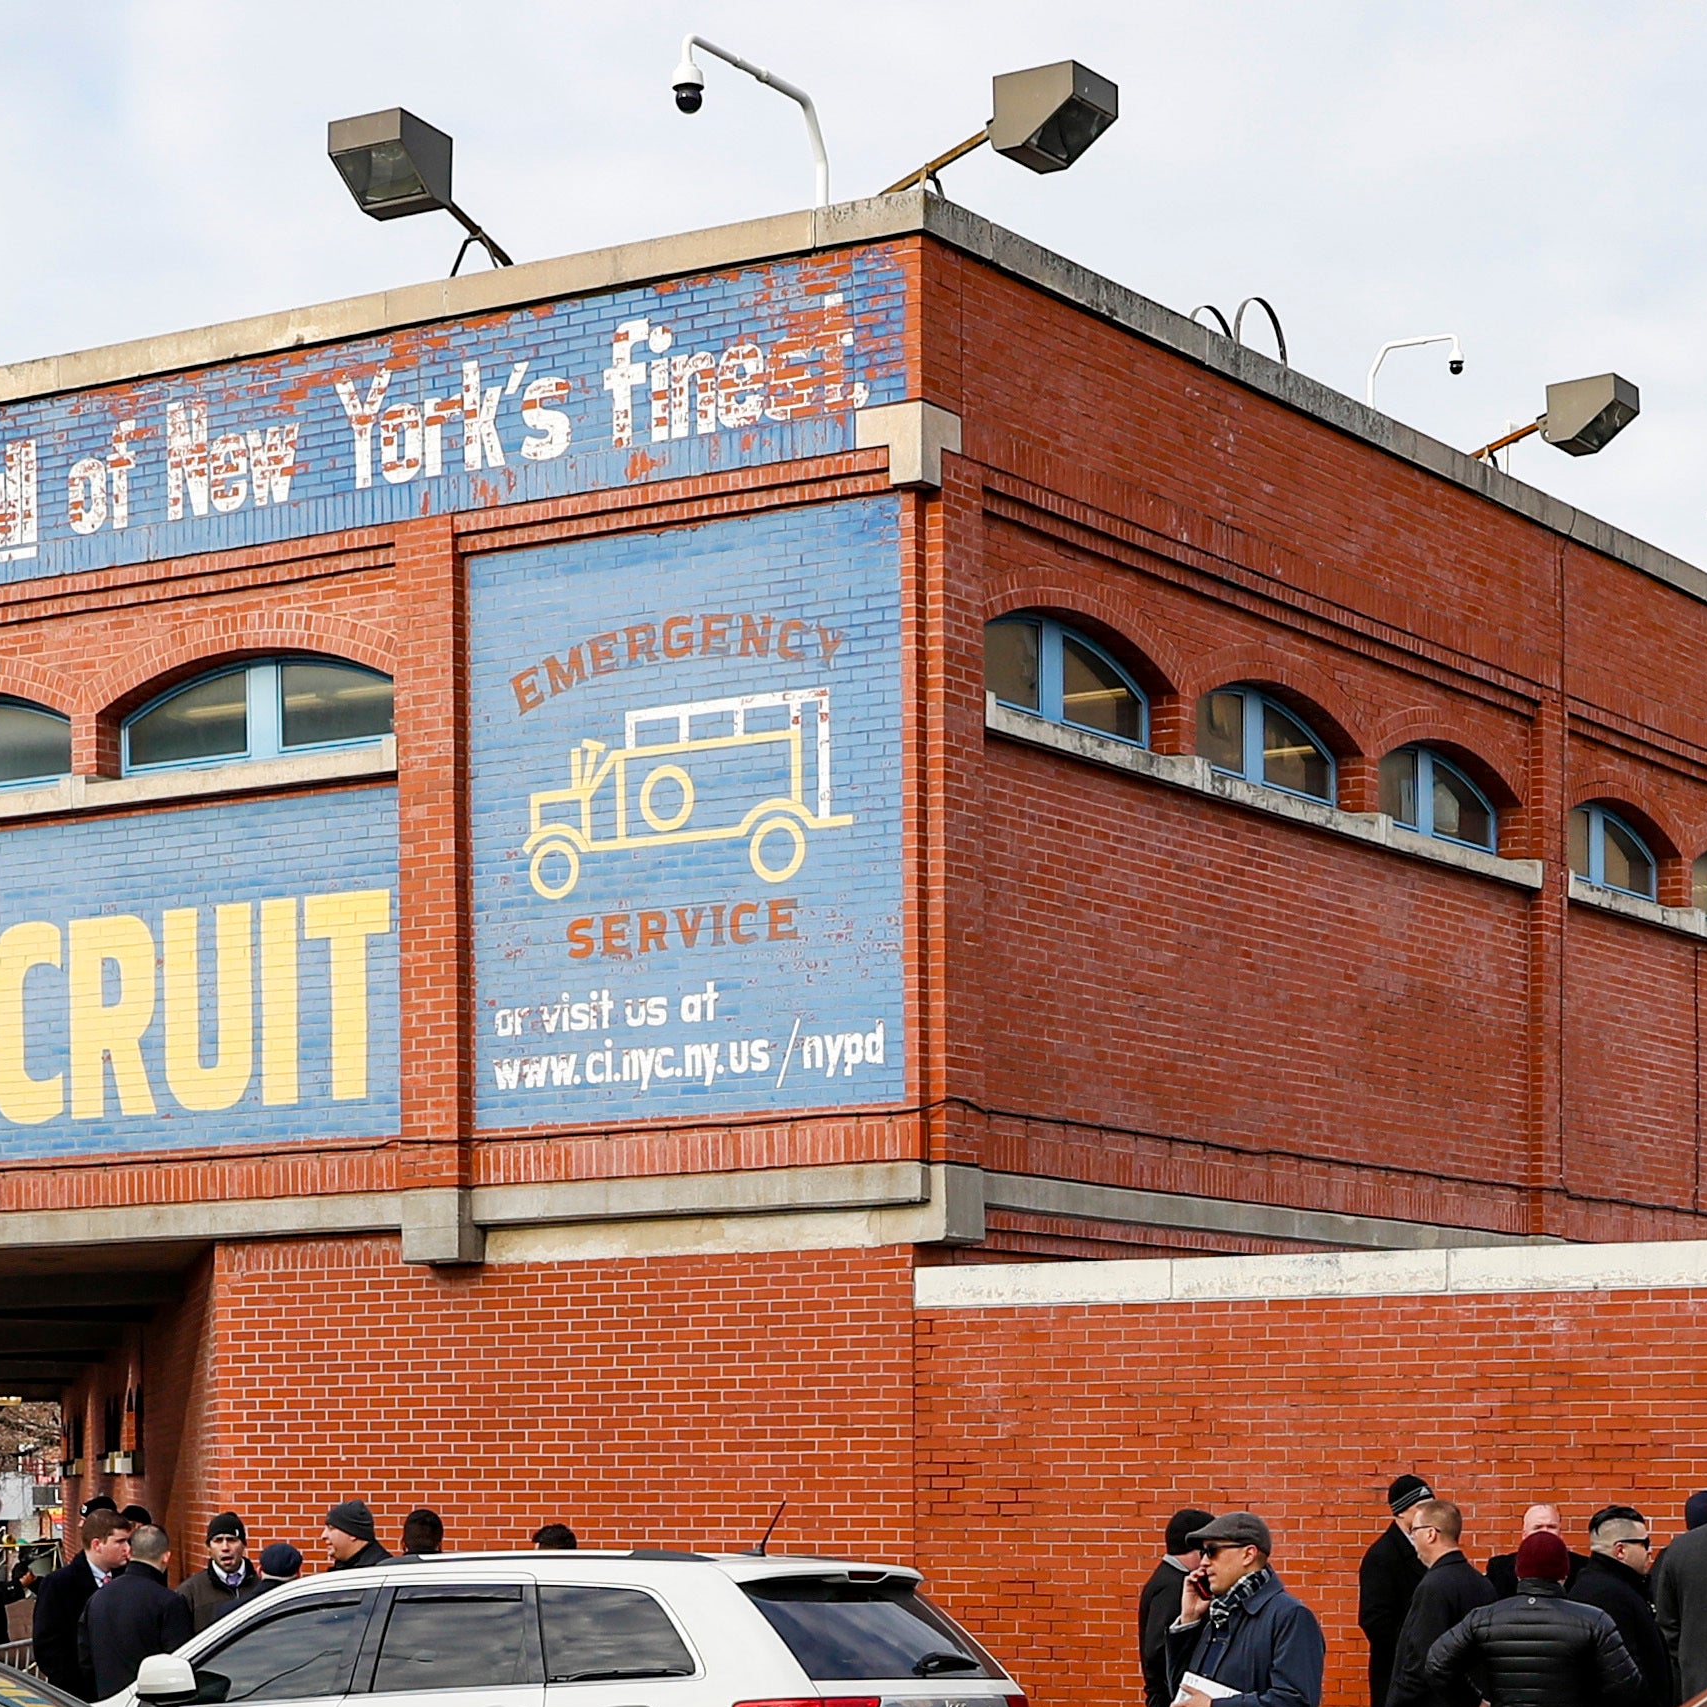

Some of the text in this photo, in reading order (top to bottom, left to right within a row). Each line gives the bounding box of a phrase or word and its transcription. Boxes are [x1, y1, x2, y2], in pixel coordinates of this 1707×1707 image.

[67, 418, 137, 536] of
[166, 400, 299, 522] New
[334, 359, 573, 491] York's
[507, 613, 851, 717] EMERGENCY
[566, 898, 803, 959] SERVICE
[494, 980, 720, 1037] or visit us at
